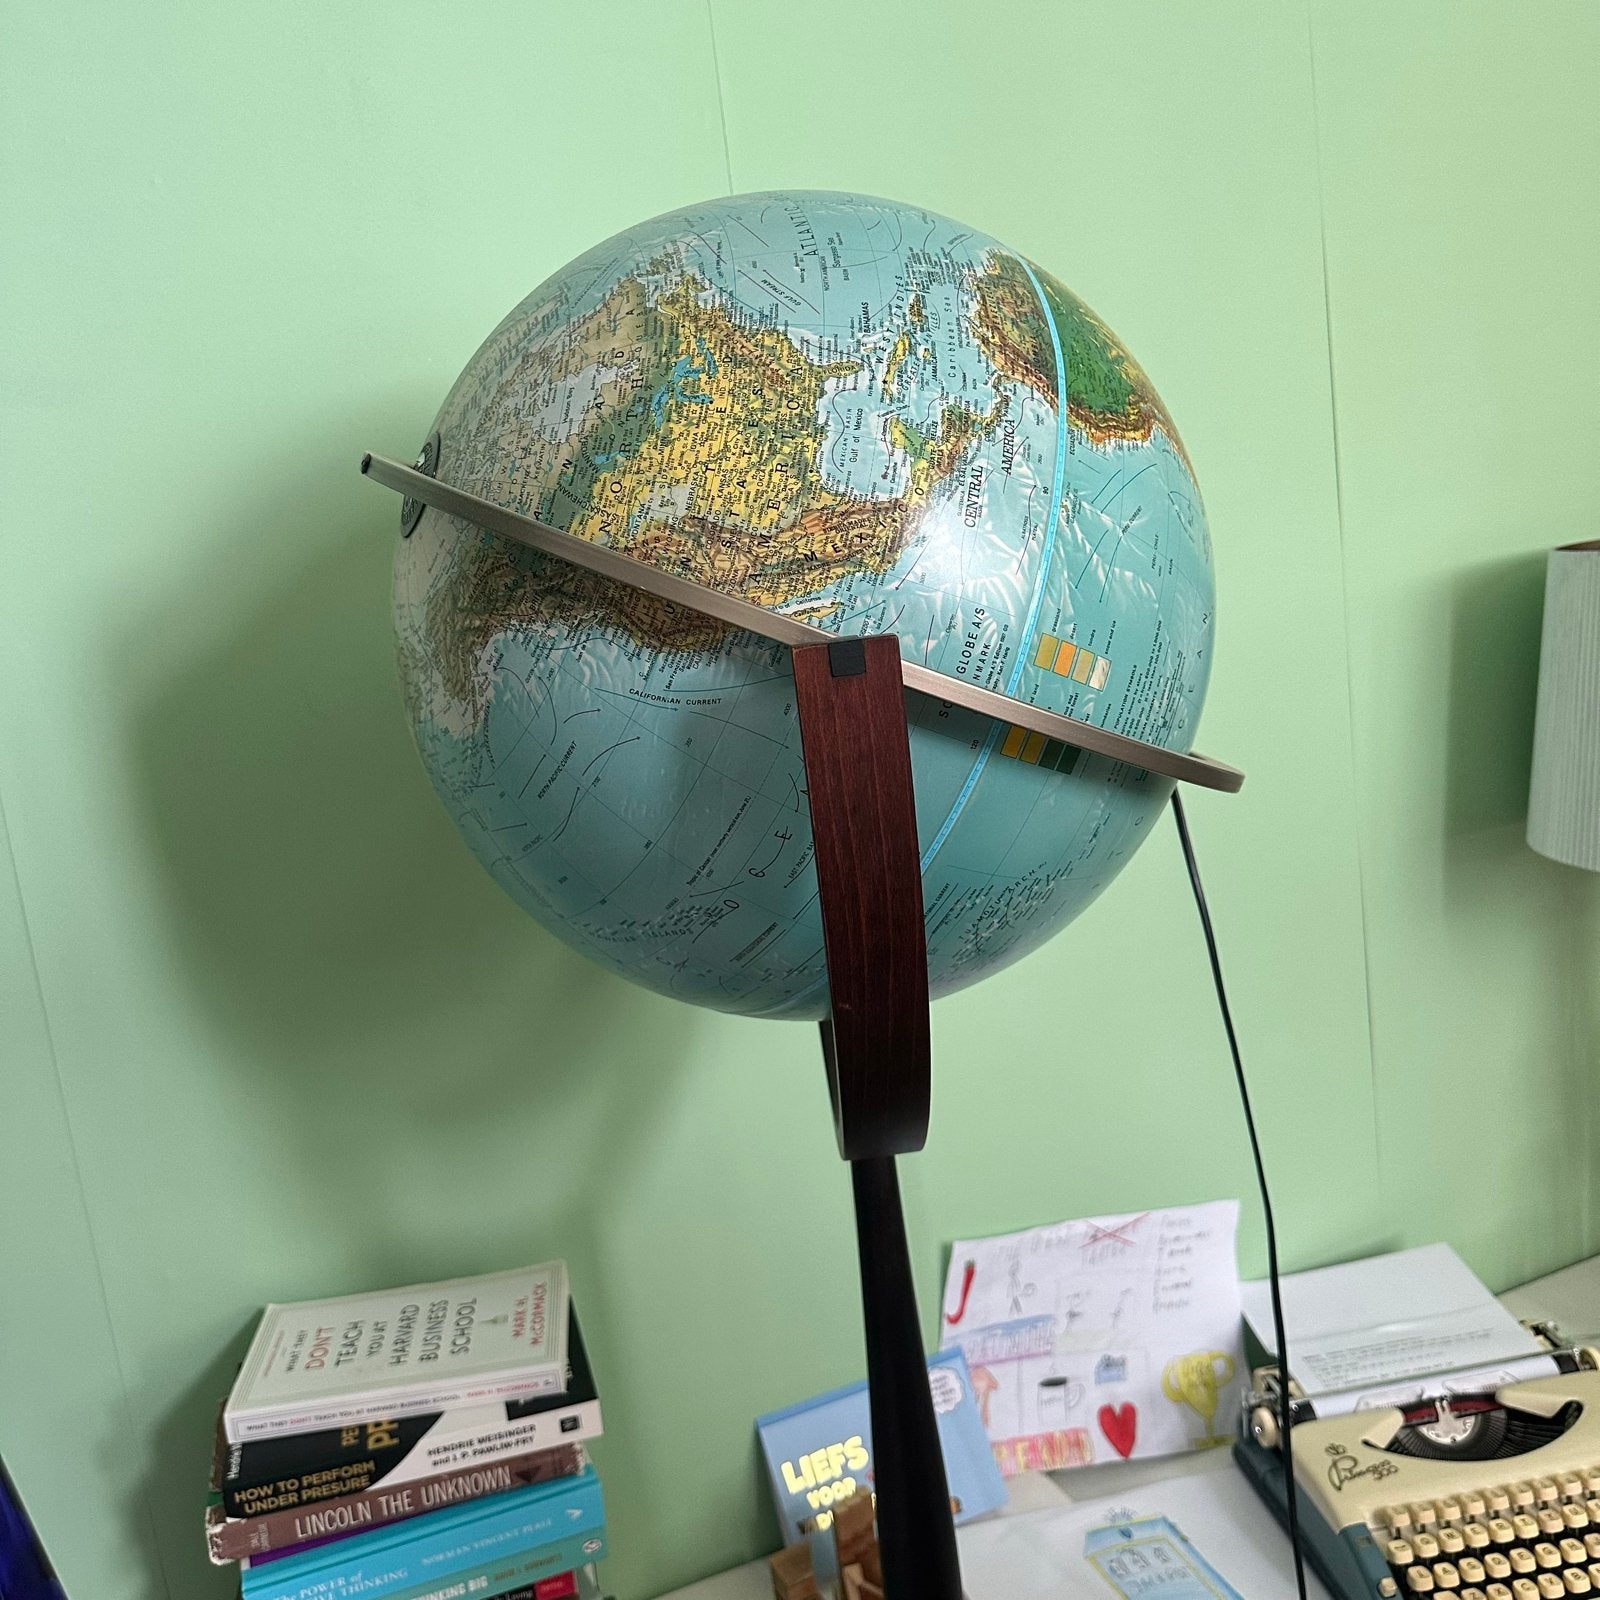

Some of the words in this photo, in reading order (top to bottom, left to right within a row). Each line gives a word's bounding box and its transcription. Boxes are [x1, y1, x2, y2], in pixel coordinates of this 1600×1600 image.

[784, 206, 818, 256] ATLANTIC
[862, 301, 872, 334] BAHAMAS
[823, 366, 856, 376] FLORIDA
[931, 356, 939, 383] JAMAICA
[854, 408, 864, 431] Mexico
[929, 420, 938, 441] BELIZE
[943, 410, 956, 443] HONDURAS
[984, 422, 993, 442] COSTA
[580, 433, 602, 474] MANITOBA
[690, 432, 698, 451] IOWA
[839, 438, 849, 467] MEXICAN
[845, 408, 853, 428] BASIN
[850, 448, 859, 462] Gulf
[958, 447, 970, 478] SALVADOR
[717, 468, 728, 498] KANSAS
[965, 466, 985, 528] CENTRAL
[1001, 419, 1016, 476] AMERICA
[685, 471, 699, 511] NEBRASKA
[631, 503, 646, 541] MONTANA
[663, 516, 678, 555] WYOMING
[706, 509, 721, 550] COLORADO
[728, 568, 739, 594] RIZONA
[1051, 608, 1063, 632] grassland
[1069, 623, 1078, 639] desert
[690, 632, 715, 669] CALIFORNIA
[956, 631, 978, 674] GLOBE
[970, 607, 985, 628] A/S
[1087, 629, 1096, 646] tundra
[668, 654, 686, 679] Francisco
[973, 643, 991, 681] NMARK
[629, 688, 681, 705] CALIFORNIAN
[686, 698, 723, 706] CURRENT
[665, 679, 674, 689] San
[1114, 694, 1128, 729] POPULATION
[1125, 665, 1138, 692] SYMBOLS
[549, 765, 564, 787] PACIFIC
[560, 741, 578, 769] CURRENT
[370, 1320, 388, 1337] AT
[389, 1303, 420, 1367] HARVARD
[419, 1299, 449, 1361] BUSINESS
[450, 1298, 477, 1356] SCHOOL
[512, 1310, 527, 1338] MARK
[304, 1326, 335, 1370] DON'T
[335, 1320, 365, 1367] TEACH
[367, 1336, 384, 1359] YOU
[426, 1437, 474, 1457] HENDRIE
[477, 1423, 537, 1445] WEISINGER
[432, 1456, 451, 1468] and
[780, 1435, 870, 1496] LIEFS
[234, 1487, 273, 1503] HOW
[276, 1480, 299, 1497] TO
[300, 1460, 375, 1489] PERFORM
[243, 1495, 300, 1516] UNDER
[301, 1475, 371, 1501] PRESURE
[806, 1476, 857, 1510] VOOR
[294, 1505, 372, 1539] LINCOLN
[378, 1490, 414, 1518] THE
[420, 1465, 512, 1507] UNKNOWN
[299, 1580, 347, 1598] POWER
[351, 1571, 363, 1585] of
[340, 1568, 408, 1595] THINKING
[468, 1576, 488, 1594] BIG
